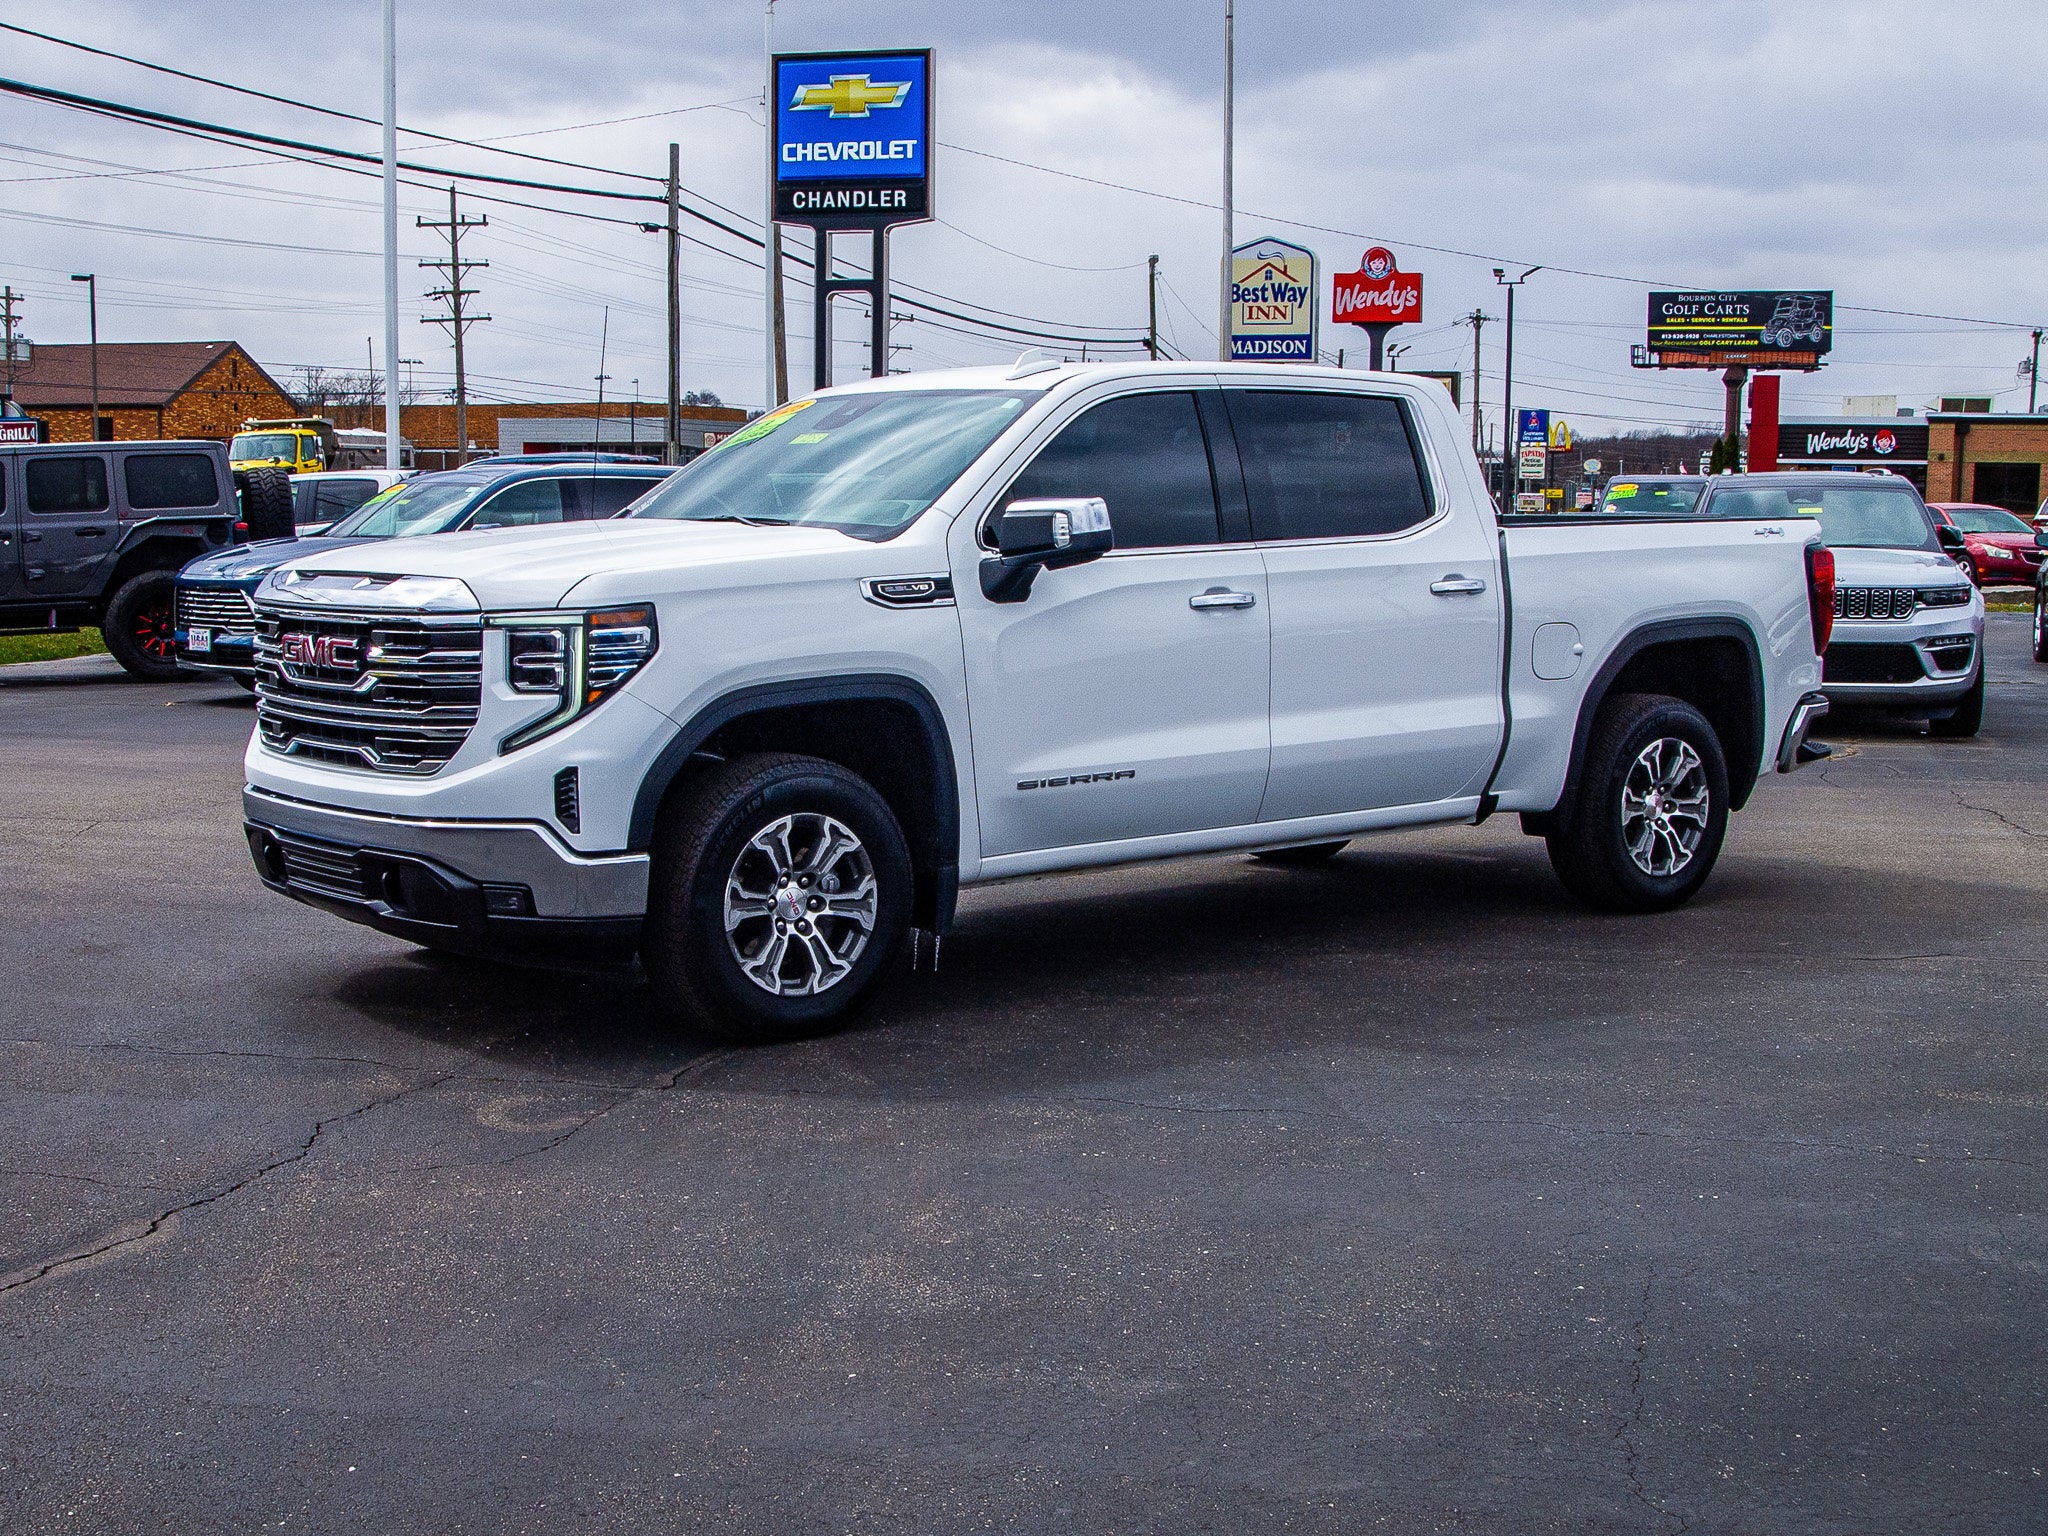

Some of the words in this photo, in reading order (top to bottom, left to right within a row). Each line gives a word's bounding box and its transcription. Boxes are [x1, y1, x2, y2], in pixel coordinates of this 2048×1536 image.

[782, 139, 918, 162] CHEVROLET
[792, 190, 907, 209] CHANDLER
[1232, 282, 1269, 303] Best
[1270, 281, 1309, 309] Way
[1335, 279, 1418, 315] Wendy's
[1246, 305, 1288, 321] INN
[1662, 302, 1700, 315] GOLF
[1704, 302, 1750, 315] CARTS
[1232, 339, 1307, 354] MADISON
[0, 426, 31, 441] GRILL
[1807, 428, 1868, 455] Wendy's
[281, 633, 360, 672] GMC
[1016, 769, 1136, 791] SIERRA
[786, 891, 800, 916] GMC
